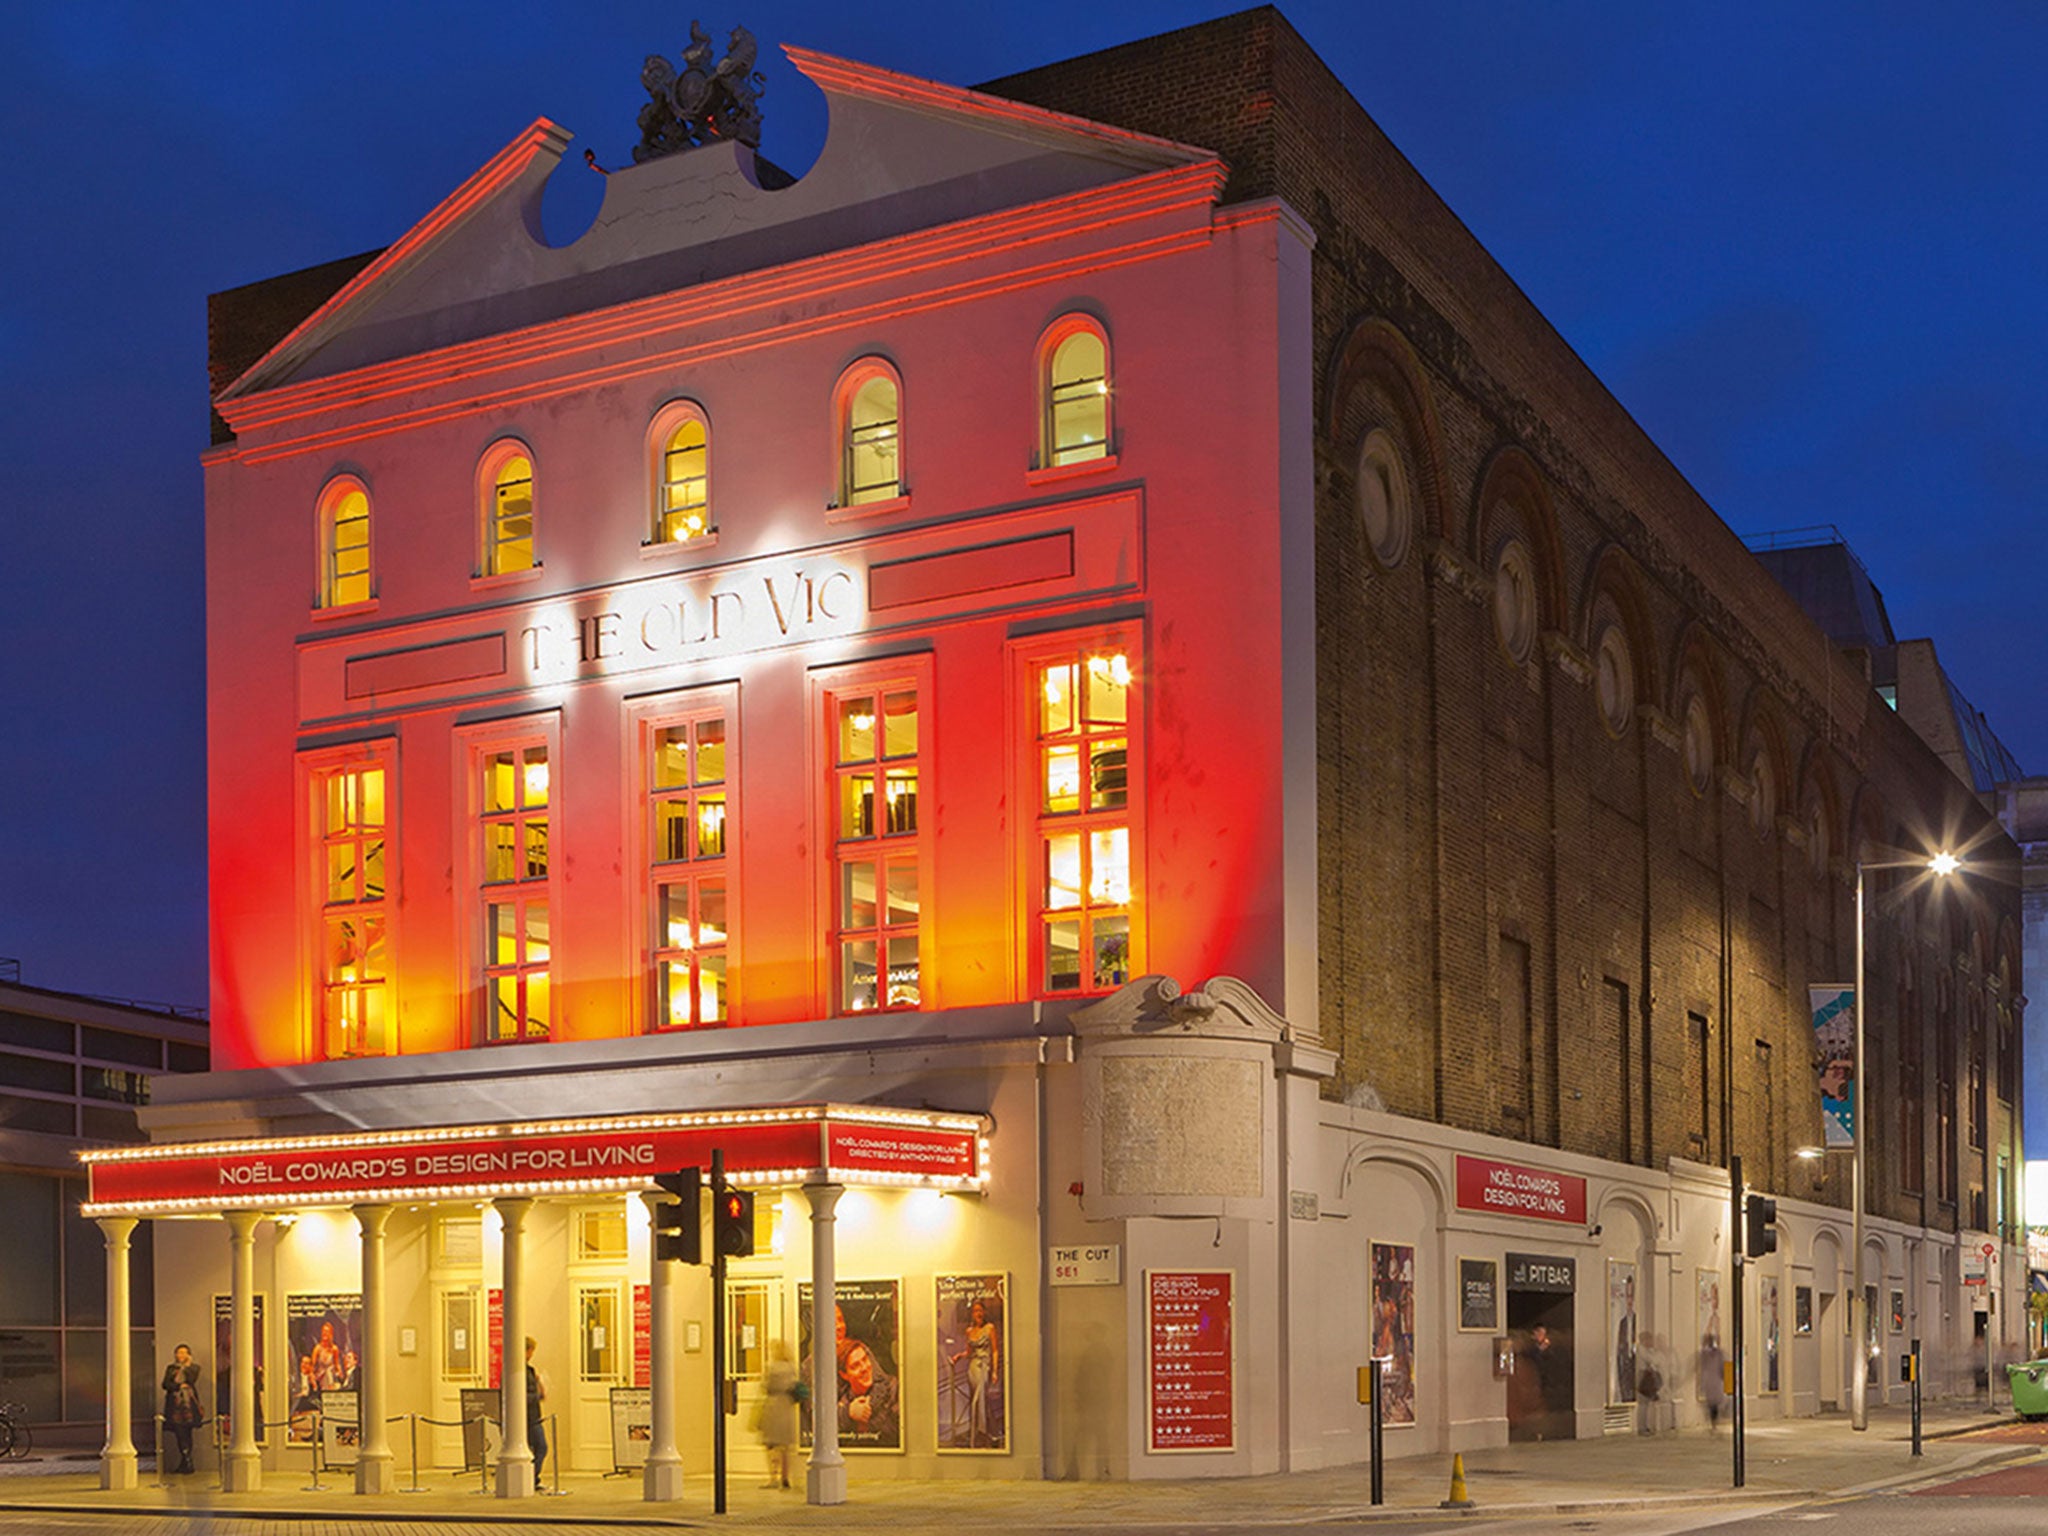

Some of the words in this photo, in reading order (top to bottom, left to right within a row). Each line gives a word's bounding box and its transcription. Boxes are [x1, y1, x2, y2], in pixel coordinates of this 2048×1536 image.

[521, 612, 624, 670] THE
[640, 592, 743, 651] OLD
[764, 570, 851, 635] VIC
[220, 1161, 284, 1185] NOËL
[286, 1158, 406, 1181] COWARD'S
[415, 1153, 507, 1175] DESIGN
[512, 1149, 566, 1170] FOR
[570, 1144, 655, 1166] LIVING
[1489, 1168, 1516, 1189] NOËL
[1516, 1174, 1560, 1196] COWARD'S
[1484, 1187, 1519, 1207] DESIGN
[1520, 1193, 1538, 1211] FOR
[1538, 1197, 1566, 1214] LIVING
[1056, 1250, 1078, 1261] THE
[1085, 1249, 1109, 1261] CUT
[1056, 1266, 1078, 1278] SE1
[1547, 1266, 1571, 1286] BAR
[1181, 1288, 1220, 1296] LIVING
